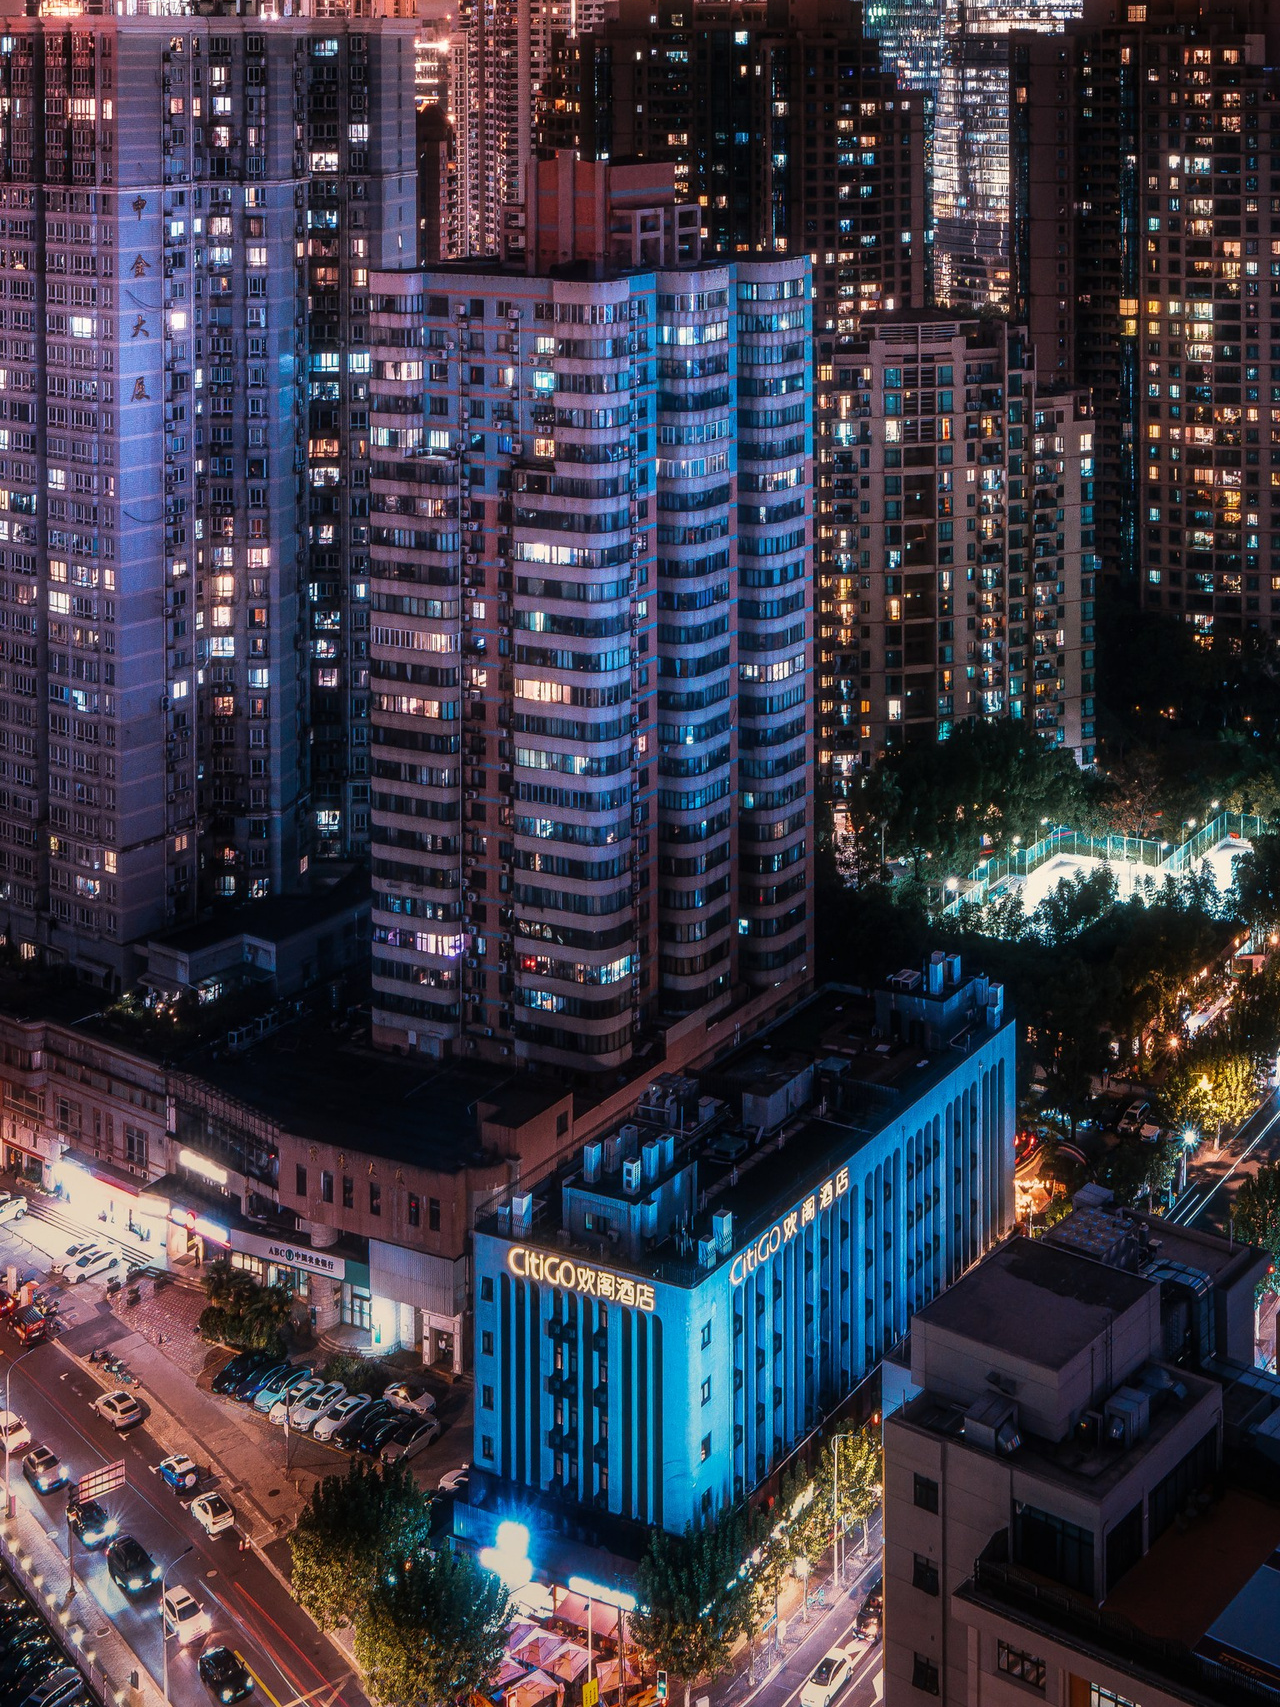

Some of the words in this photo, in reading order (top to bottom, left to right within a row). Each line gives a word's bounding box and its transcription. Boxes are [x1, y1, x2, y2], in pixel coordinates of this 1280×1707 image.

[268, 1246, 285, 1258] ABC
[294, 1251, 334, 1270] 中国农业银行
[729, 1225, 781, 1285] CitiGO
[783, 1166, 849, 1243] 欢阁酒店
[508, 1246, 576, 1288] CitiGO
[577, 1267, 656, 1312] 欢阁酒店
